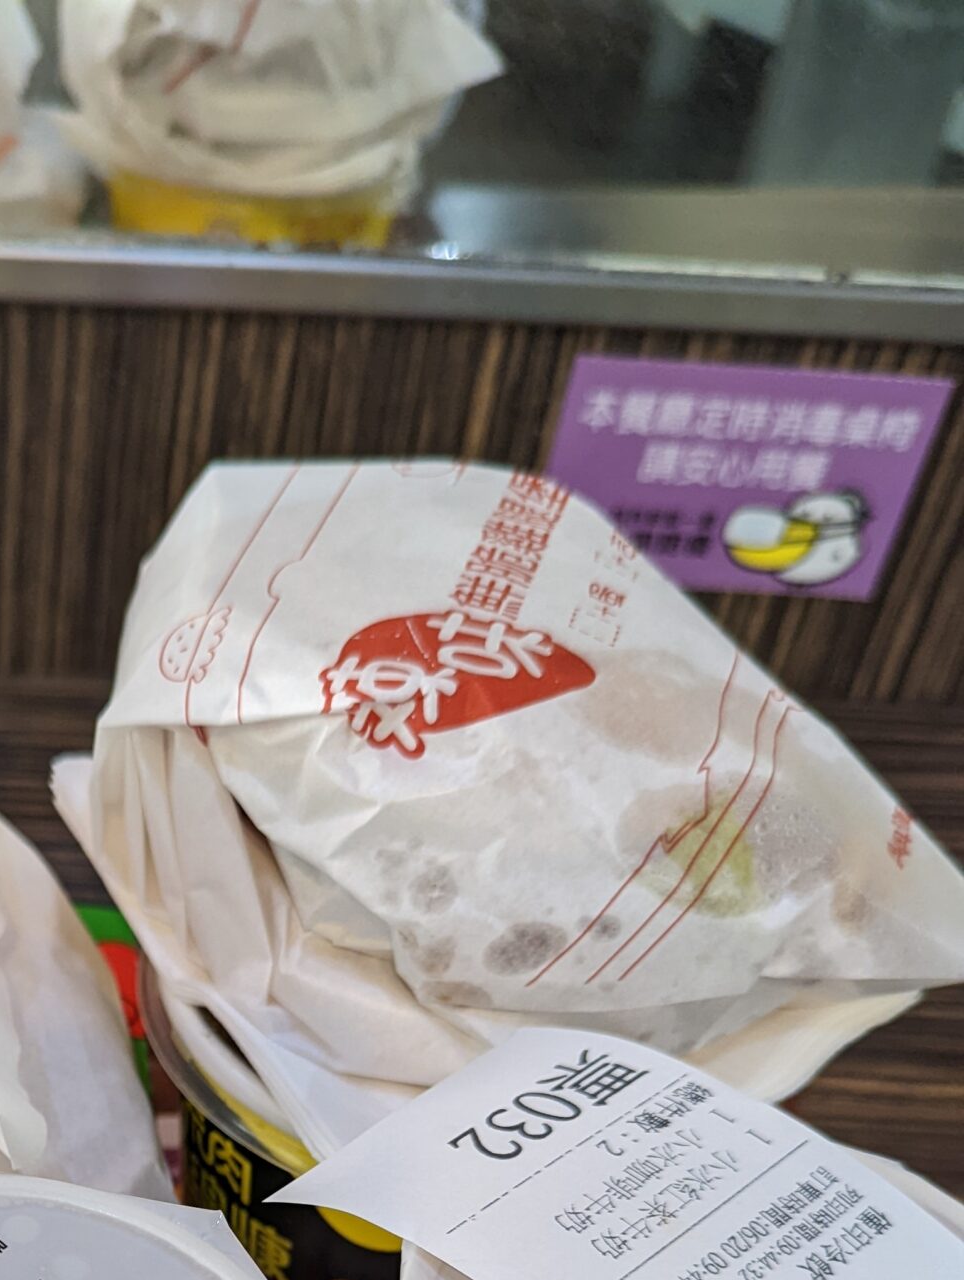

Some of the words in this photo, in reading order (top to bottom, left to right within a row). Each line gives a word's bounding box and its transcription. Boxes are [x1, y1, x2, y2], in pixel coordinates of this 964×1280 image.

[326, 608, 553, 755] 辣味
[446, 1048, 651, 1162] 票032
[553, 1129, 704, 1235] 小冰咖啡牛奶
[589, 1151, 738, 1261] 小冰紅茶牛奶
